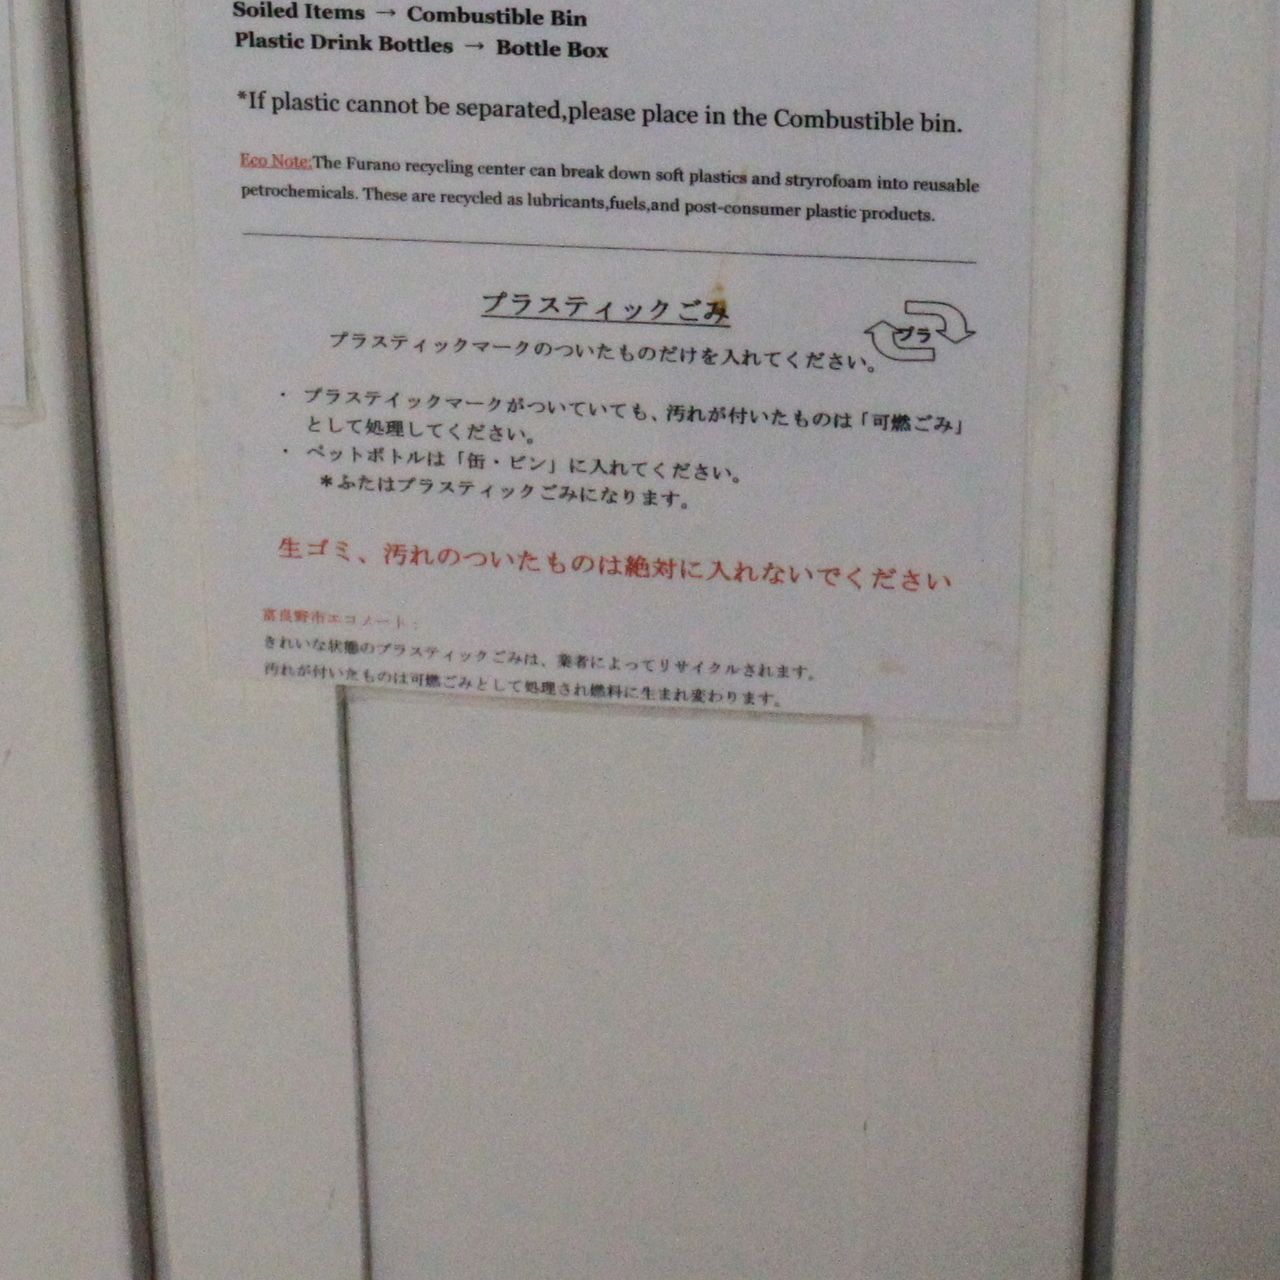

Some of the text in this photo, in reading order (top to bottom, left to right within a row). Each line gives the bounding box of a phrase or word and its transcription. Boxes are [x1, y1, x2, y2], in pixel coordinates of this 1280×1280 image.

[232, 0, 588, 28] Soiled Items Combustible Bin
[234, 29, 609, 59] Plastic Drink Bottles Bottle Box
[240, 184, 359, 201] petrochemicals.
[361, 187, 409, 203] These
[410, 191, 437, 204] are
[439, 191, 504, 208] recycled
[506, 194, 525, 207] as
[683, 201, 803, 218] post-consumer
[804, 202, 858, 222] plastic
[859, 205, 936, 224] products.
[481, 290, 730, 322] プラスティックごみ
[330, 330, 884, 374] プラスティックマークのついたものだけを入れてください。
[307, 415, 534, 446] として処理してください。
[278, 535, 953, 593] 生ゴミ、汚れのついたものは絶対に入れないでください
